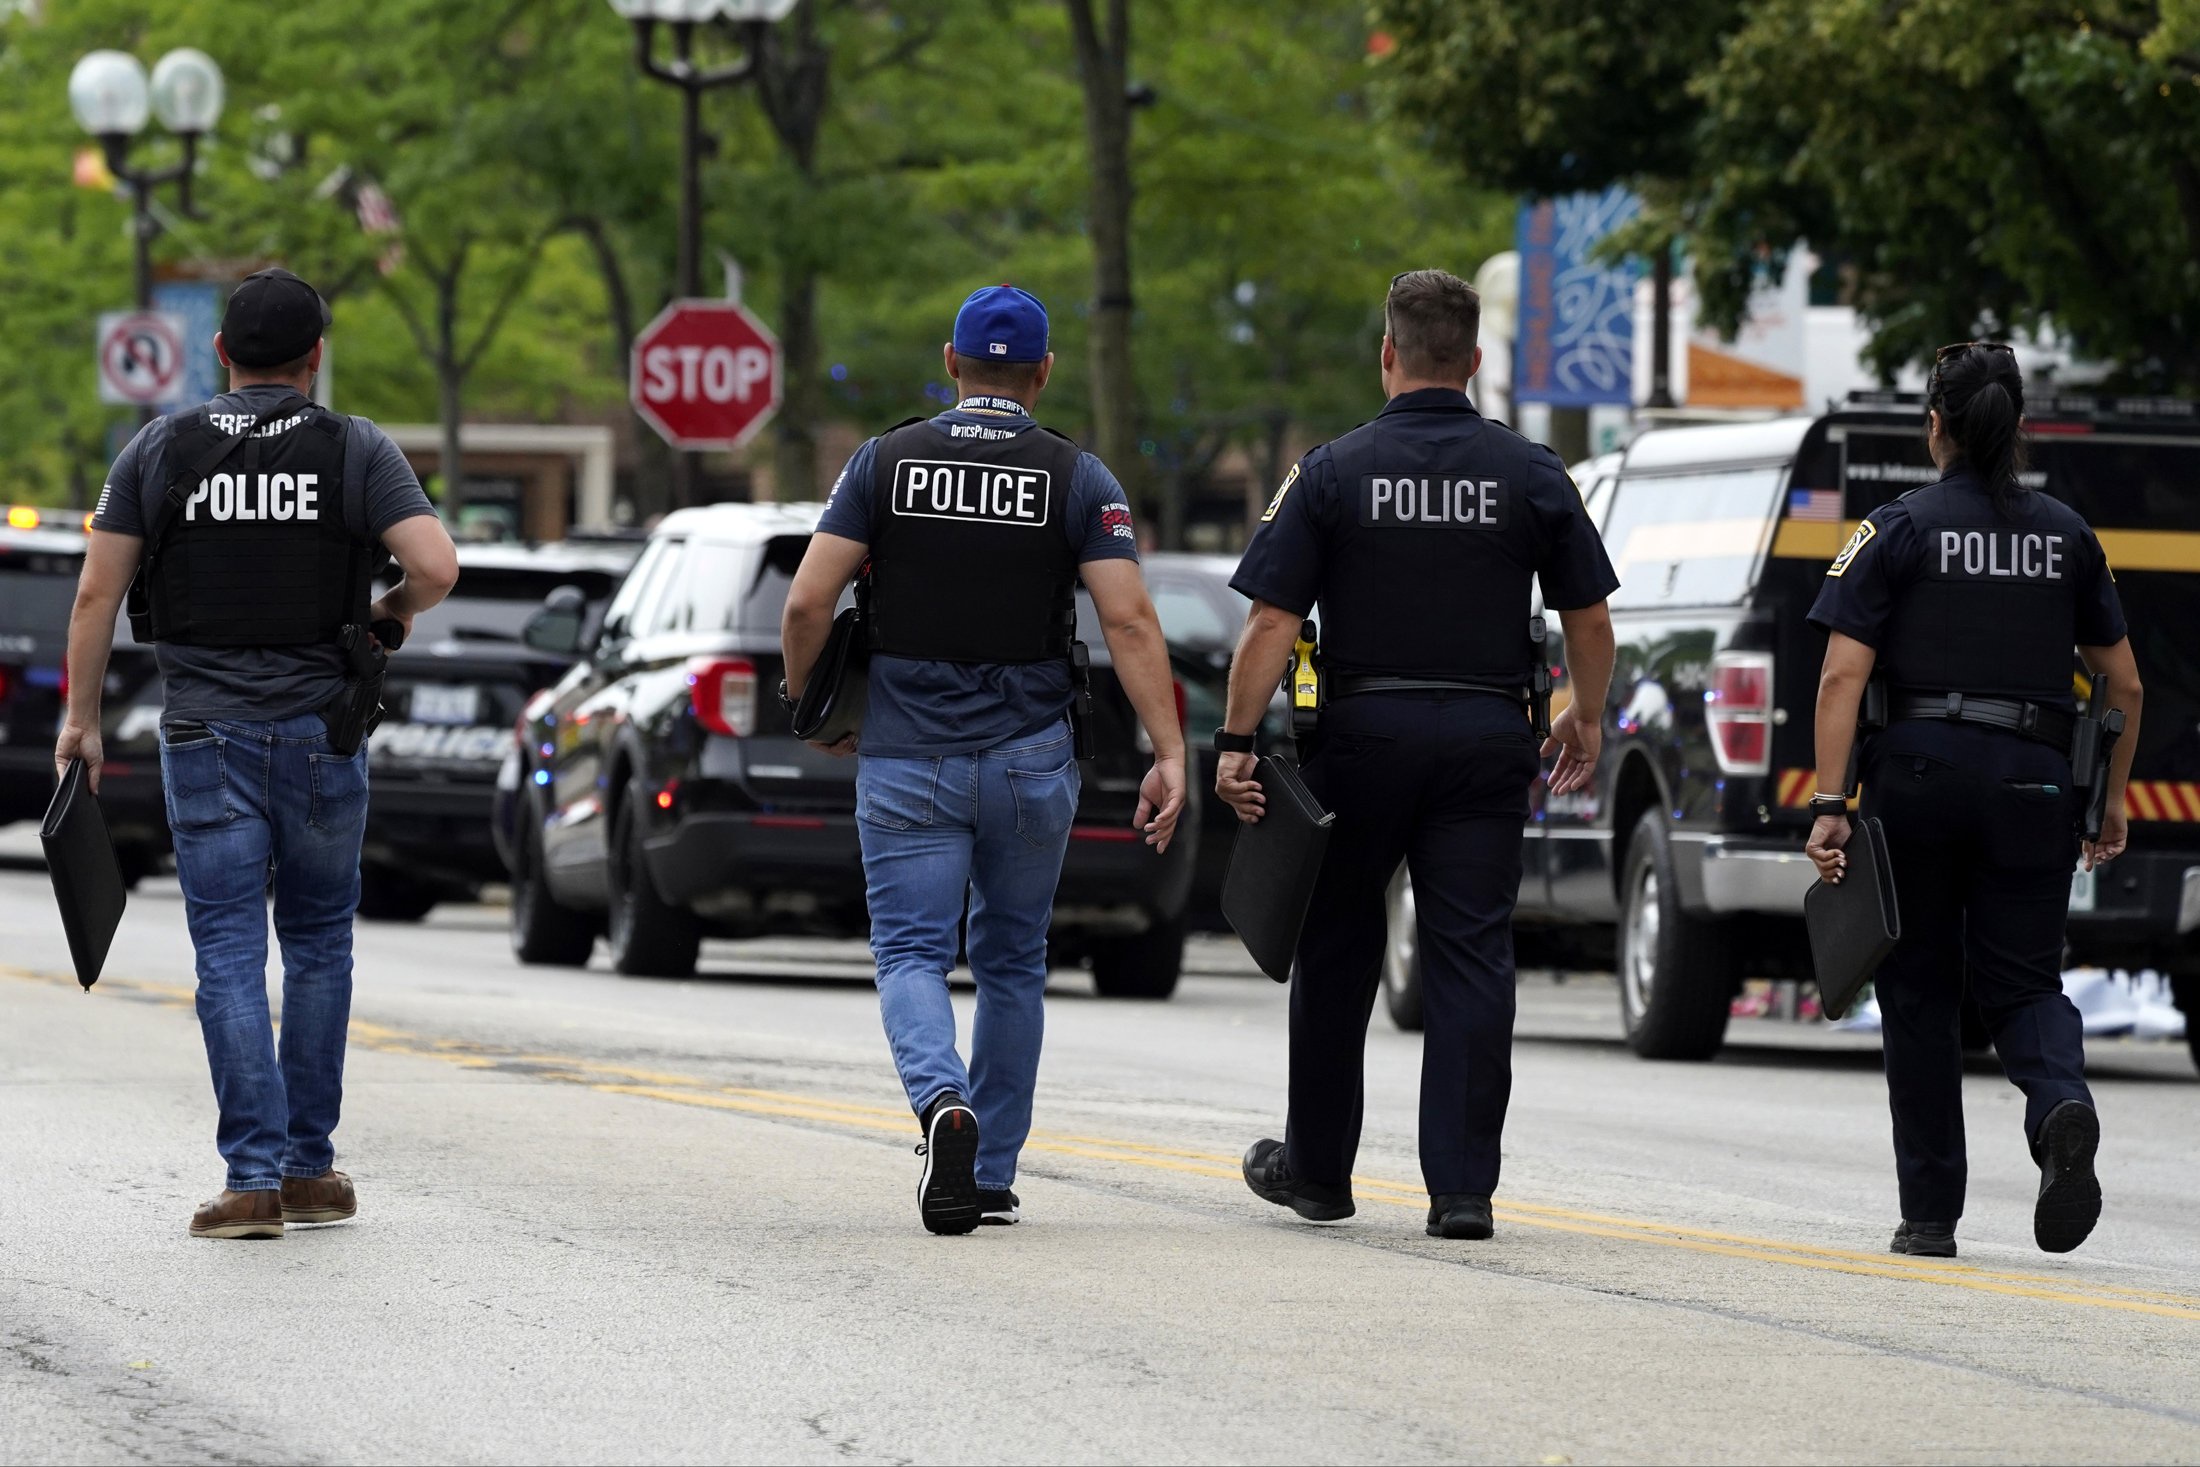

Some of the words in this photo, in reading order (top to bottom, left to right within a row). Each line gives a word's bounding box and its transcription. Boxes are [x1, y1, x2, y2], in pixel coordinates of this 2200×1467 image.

[644, 345, 770, 404] STOP
[963, 396, 990, 408] COUNTY
[992, 397, 1026, 415] SHERIFF'S
[185, 473, 319, 521] POLICE
[907, 467, 1037, 518] POLICE
[1372, 478, 1498, 524] POLICE
[1941, 531, 2063, 580] POLICE
